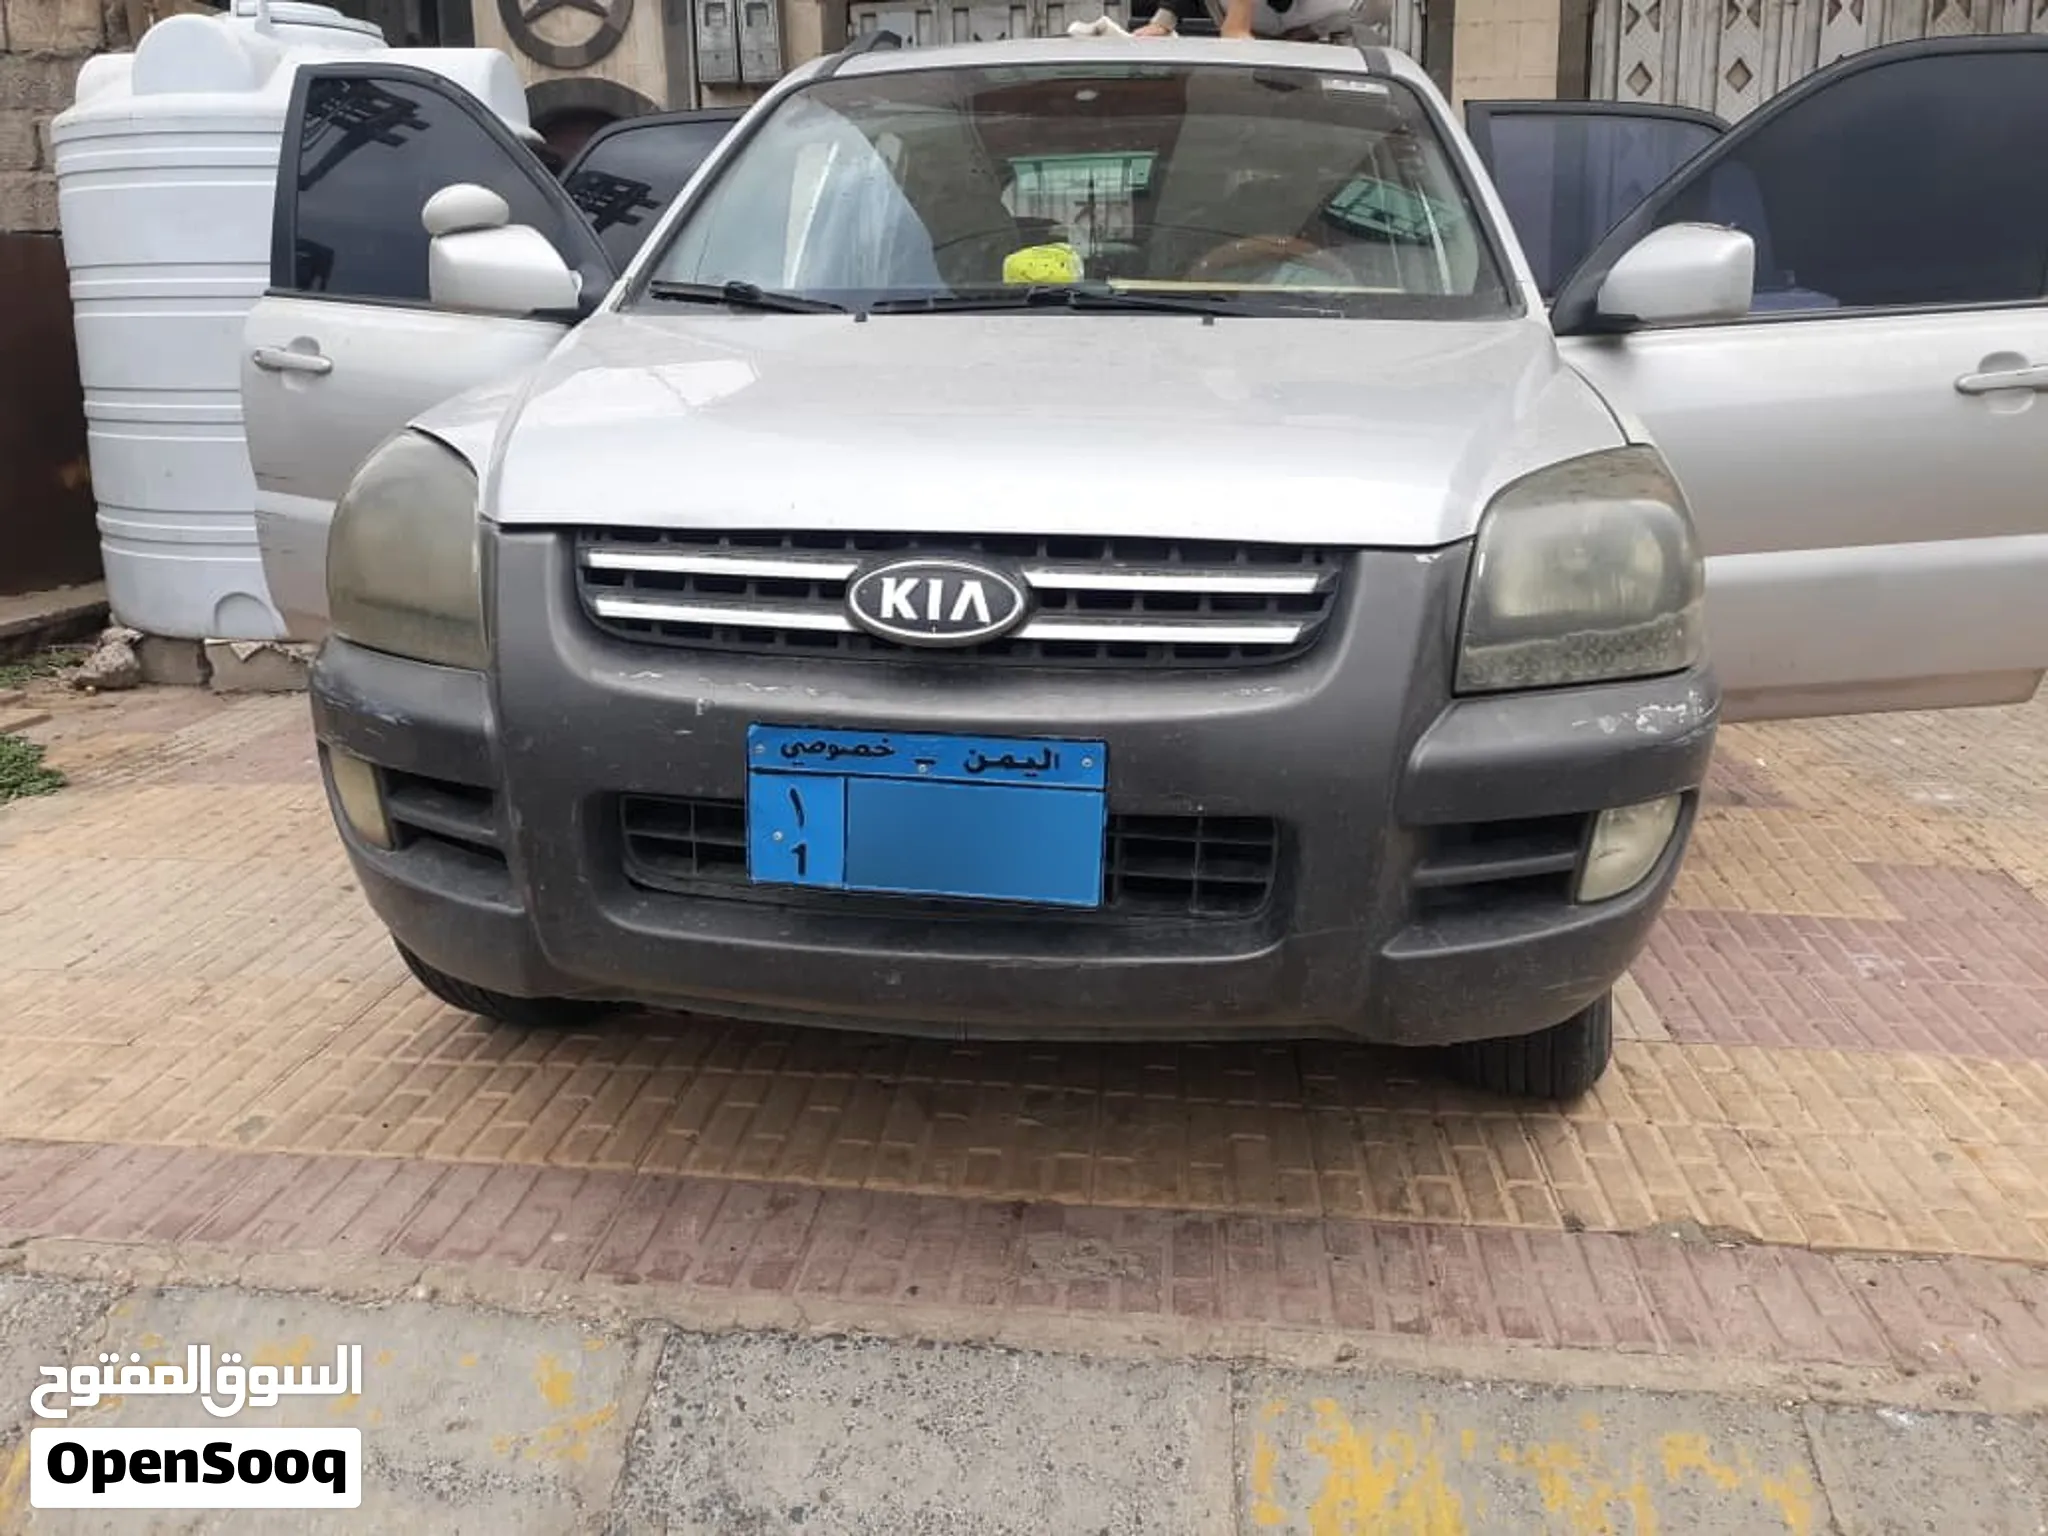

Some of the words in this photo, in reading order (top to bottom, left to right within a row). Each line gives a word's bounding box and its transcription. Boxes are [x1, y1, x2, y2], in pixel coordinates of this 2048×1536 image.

[880, 577, 991, 622] KIA
[780, 738, 896, 766] خصوصي
[963, 747, 1059, 777] اليمن
